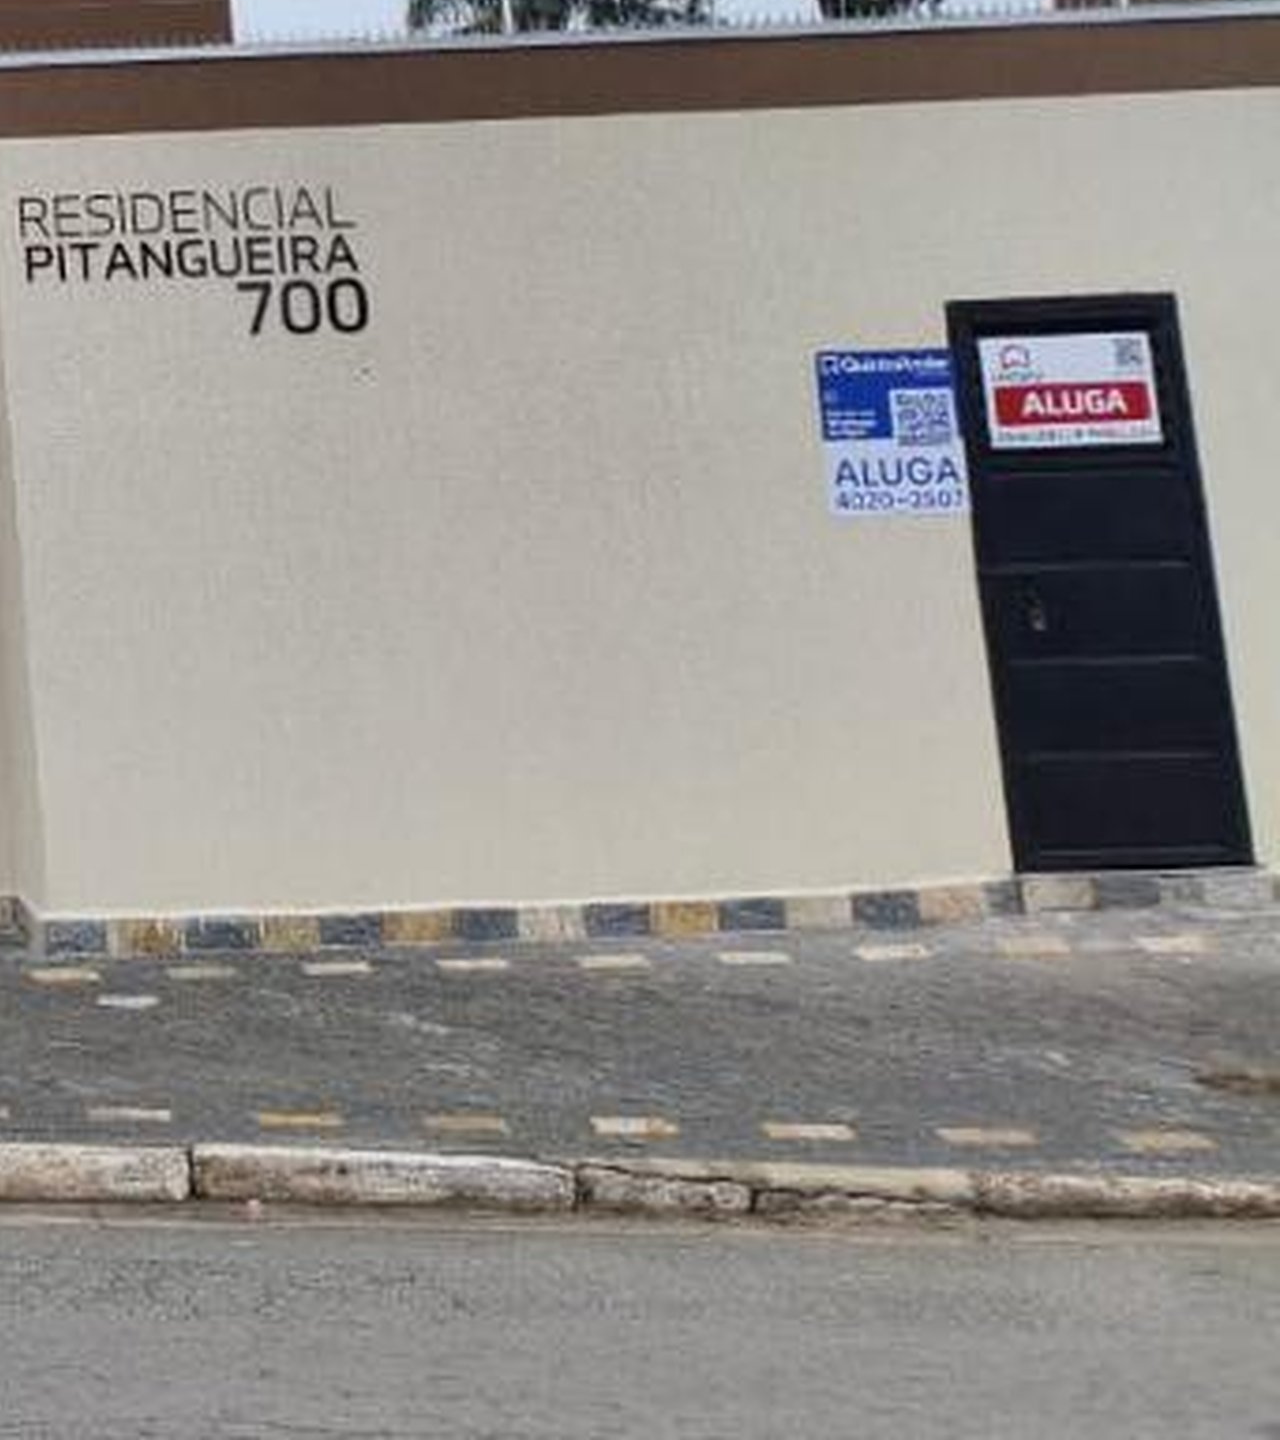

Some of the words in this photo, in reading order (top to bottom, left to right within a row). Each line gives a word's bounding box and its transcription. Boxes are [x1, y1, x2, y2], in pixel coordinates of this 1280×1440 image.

[18, 187, 358, 239] RESIDENCIAL
[25, 235, 360, 282] PITANGUEIRA
[237, 278, 370, 336] 700
[1021, 388, 1129, 418] ALUGA
[835, 456, 961, 488] ALUGA
